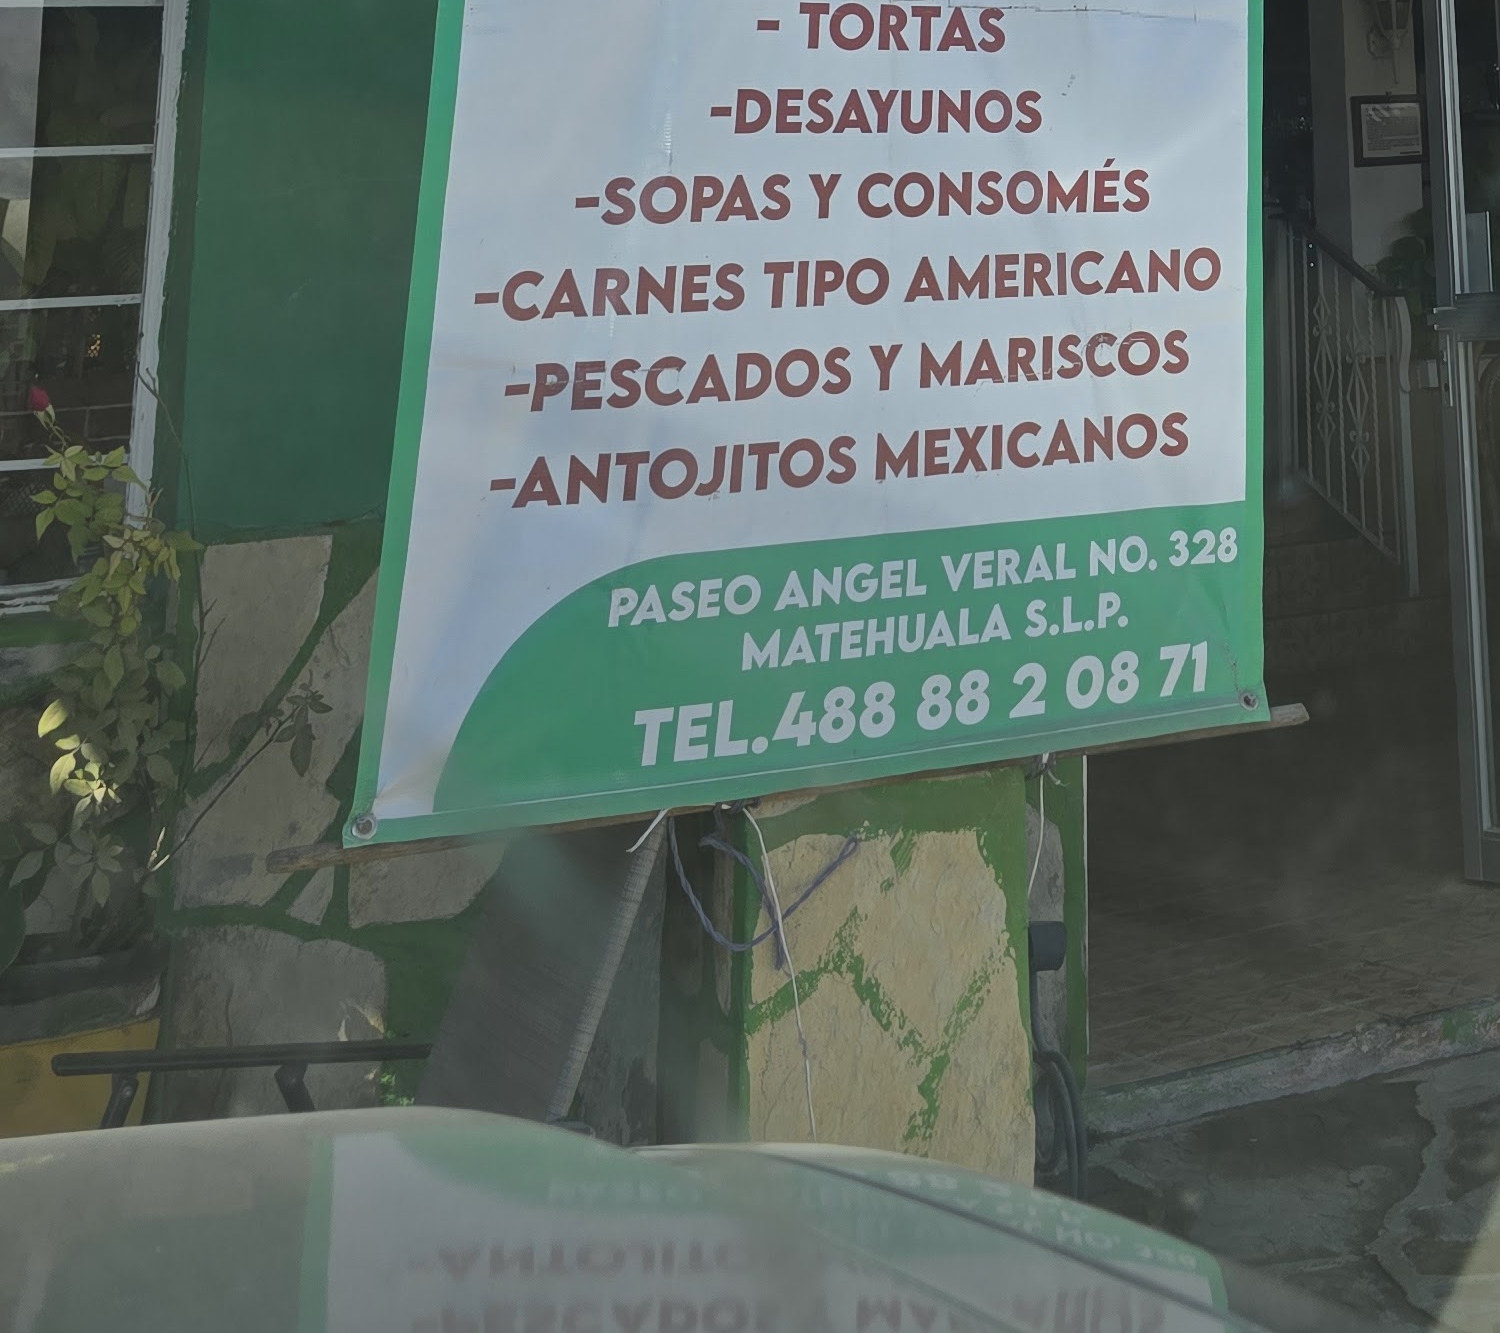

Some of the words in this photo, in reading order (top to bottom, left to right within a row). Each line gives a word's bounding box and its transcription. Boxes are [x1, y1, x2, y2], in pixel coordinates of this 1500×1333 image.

[800, 2, 1005, 52] TORTAS
[710, 89, 1042, 134] -DESAYUNOS
[575, 174, 790, 225] -SOPAS
[809, 173, 841, 219] Y
[857, 159, 1150, 218] CONSOMÉS
[474, 262, 744, 321] -CARNES
[763, 258, 889, 307] TIPO
[904, 247, 1221, 303] AMERICANO
[504, 348, 850, 412] -PESCADOS
[870, 343, 902, 391] Y
[919, 330, 1190, 389] MARISCOS
[489, 436, 856, 508] -ANTOJITOS
[875, 412, 1189, 481] MEXICANOS
[609, 574, 762, 628] PASEO
[774, 558, 928, 611] ANGEL
[941, 542, 1078, 592] VERAL
[1089, 535, 1158, 577] NO.
[1168, 526, 1239, 567] 328
[740, 604, 1011, 671] MATEHUALA
[1025, 591, 1129, 637] S.L.P.
[634, 682, 896, 767] TEL.488
[916, 669, 990, 730] 88
[1009, 662, 1047, 719] 2
[1065, 650, 1140, 709] 08
[1159, 640, 1208, 697] 71
